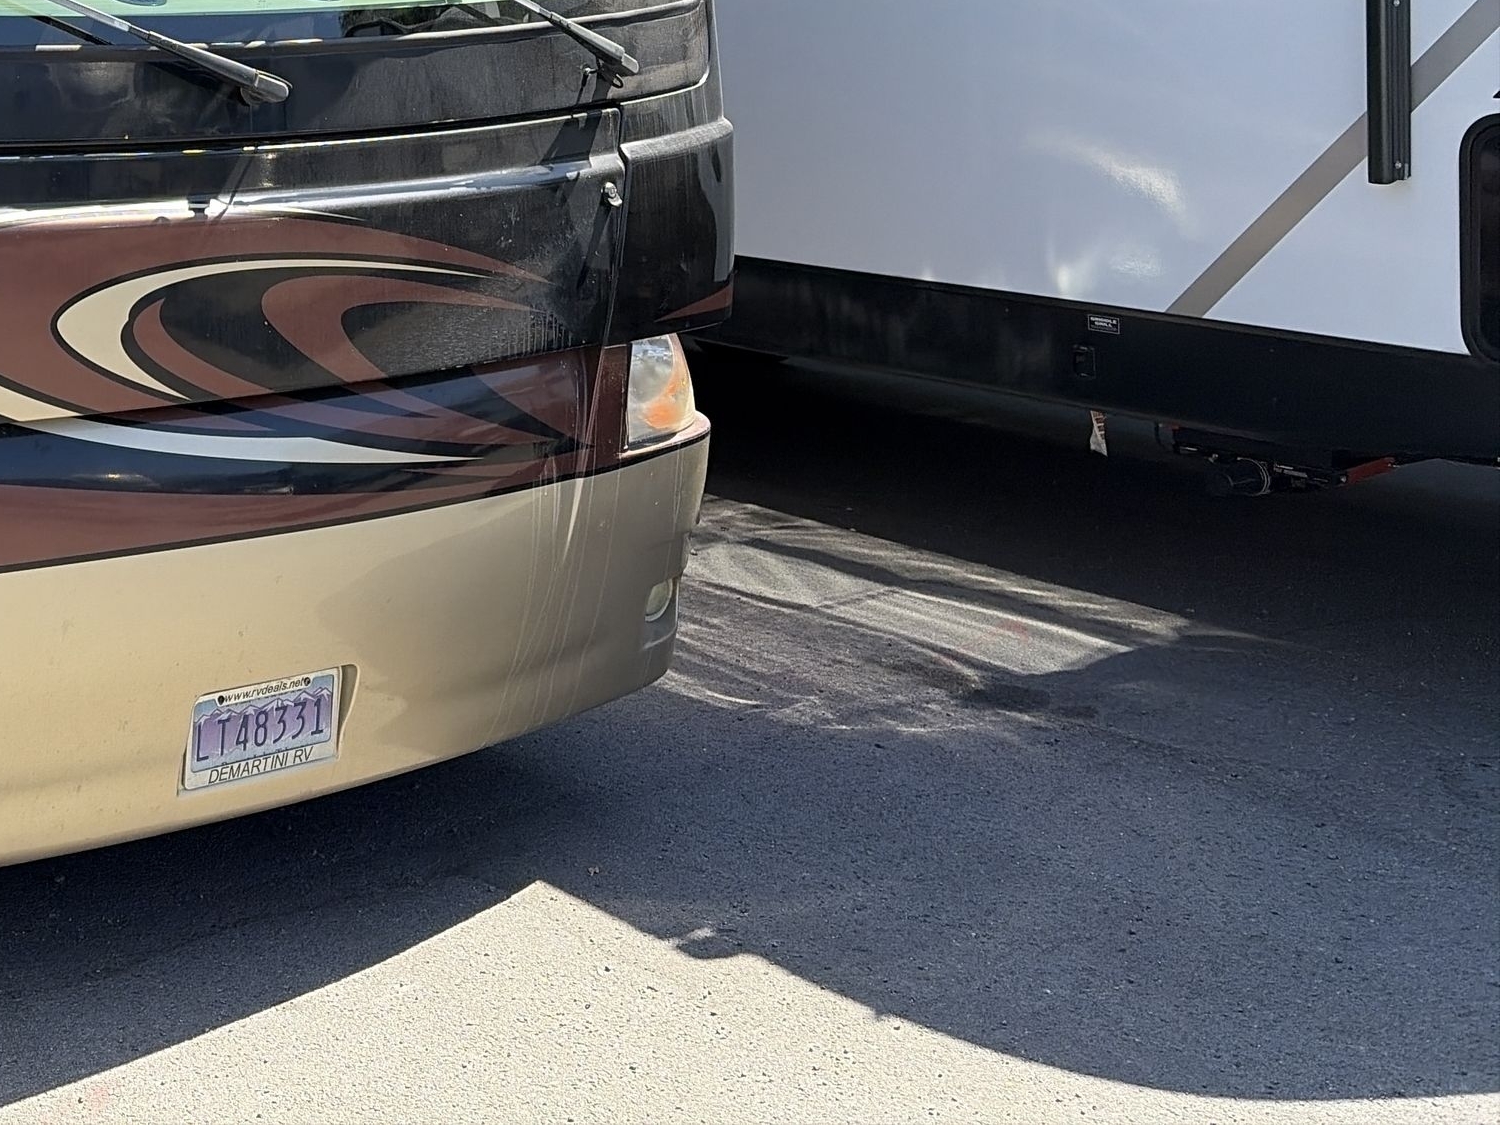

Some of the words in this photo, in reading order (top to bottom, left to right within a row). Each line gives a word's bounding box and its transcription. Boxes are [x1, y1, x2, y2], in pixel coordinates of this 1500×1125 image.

[223, 676, 305, 703] www.rvdeals.net
[195, 697, 323, 762] LT48331
[208, 752, 289, 785] DEMARTINI
[293, 746, 314, 764] RV
